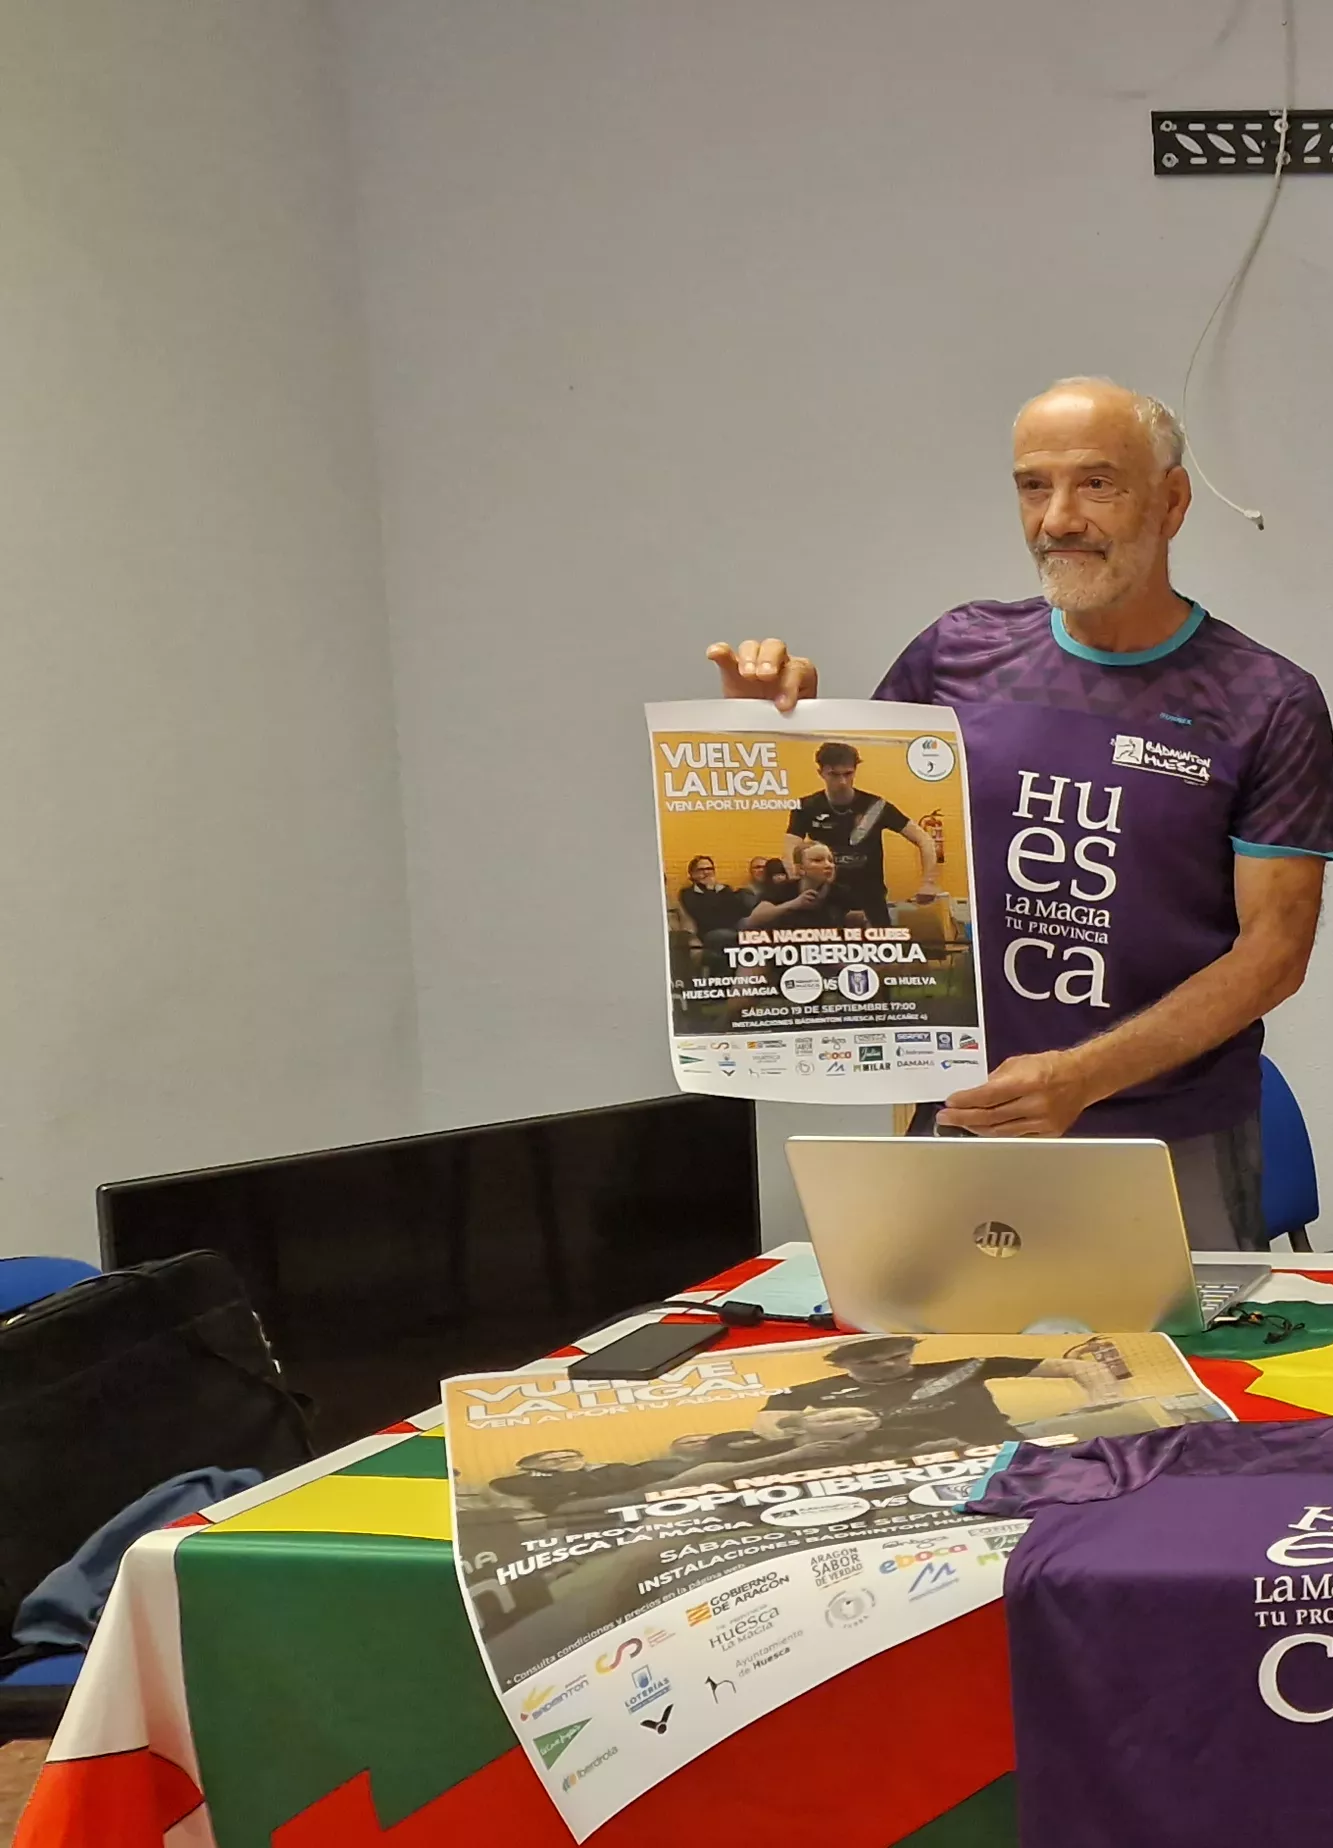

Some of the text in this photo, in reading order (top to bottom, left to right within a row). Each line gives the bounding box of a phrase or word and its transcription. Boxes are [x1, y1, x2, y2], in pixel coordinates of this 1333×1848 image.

[660, 742, 778, 768] VUELVE
[664, 769, 790, 797] LA LIGA!
[666, 801, 691, 812] VEN
[694, 801, 705, 811] A
[706, 800, 731, 811] POR
[734, 800, 750, 810] TU
[1007, 826, 1117, 901] es
[739, 928, 911, 944] LIGA NACIONAL DE CLUBES
[725, 943, 926, 968] TOP10 IBERDROLA
[692, 976, 936, 987] TU PROVINCIA HUELVA
[1003, 937, 1111, 1009] ca
[683, 986, 779, 1000] HUESCA LA MAGIA
[805, 1005, 820, 1014] DE
[822, 1003, 888, 1013] SEPTIEMBRE
[467, 1373, 764, 1421] LA LIGA!
[467, 1387, 792, 1430] VEN A POR TU ABONO!
[645, 1450, 959, 1503] LIGA NACIONAL DE
[606, 1484, 802, 1524] TOP10
[521, 1493, 910, 1551] TU PROVINCIA VS
[496, 1539, 613, 1586] HUESCA
[617, 1532, 653, 1547] LA
[659, 1520, 753, 1540] MAGIA
[660, 1519, 867, 1564] SÁBADO 19 DE
[638, 1522, 929, 1595] INSTALACIONES BADMINTON
[811, 1553, 861, 1578] SABOR
[828, 1563, 863, 1583] VERDAD
[879, 1544, 968, 1574] eboca
[710, 1571, 778, 1607] GOBIERNO
[712, 1601, 730, 1616] DE
[513, 1656, 555, 1684] Consulta
[557, 1622, 614, 1659] condiciones
[624, 1599, 662, 1624] precios
[662, 1592, 675, 1602] en
[735, 1629, 804, 1668] Ayuntamiento
[753, 1646, 791, 1670] Huesca
